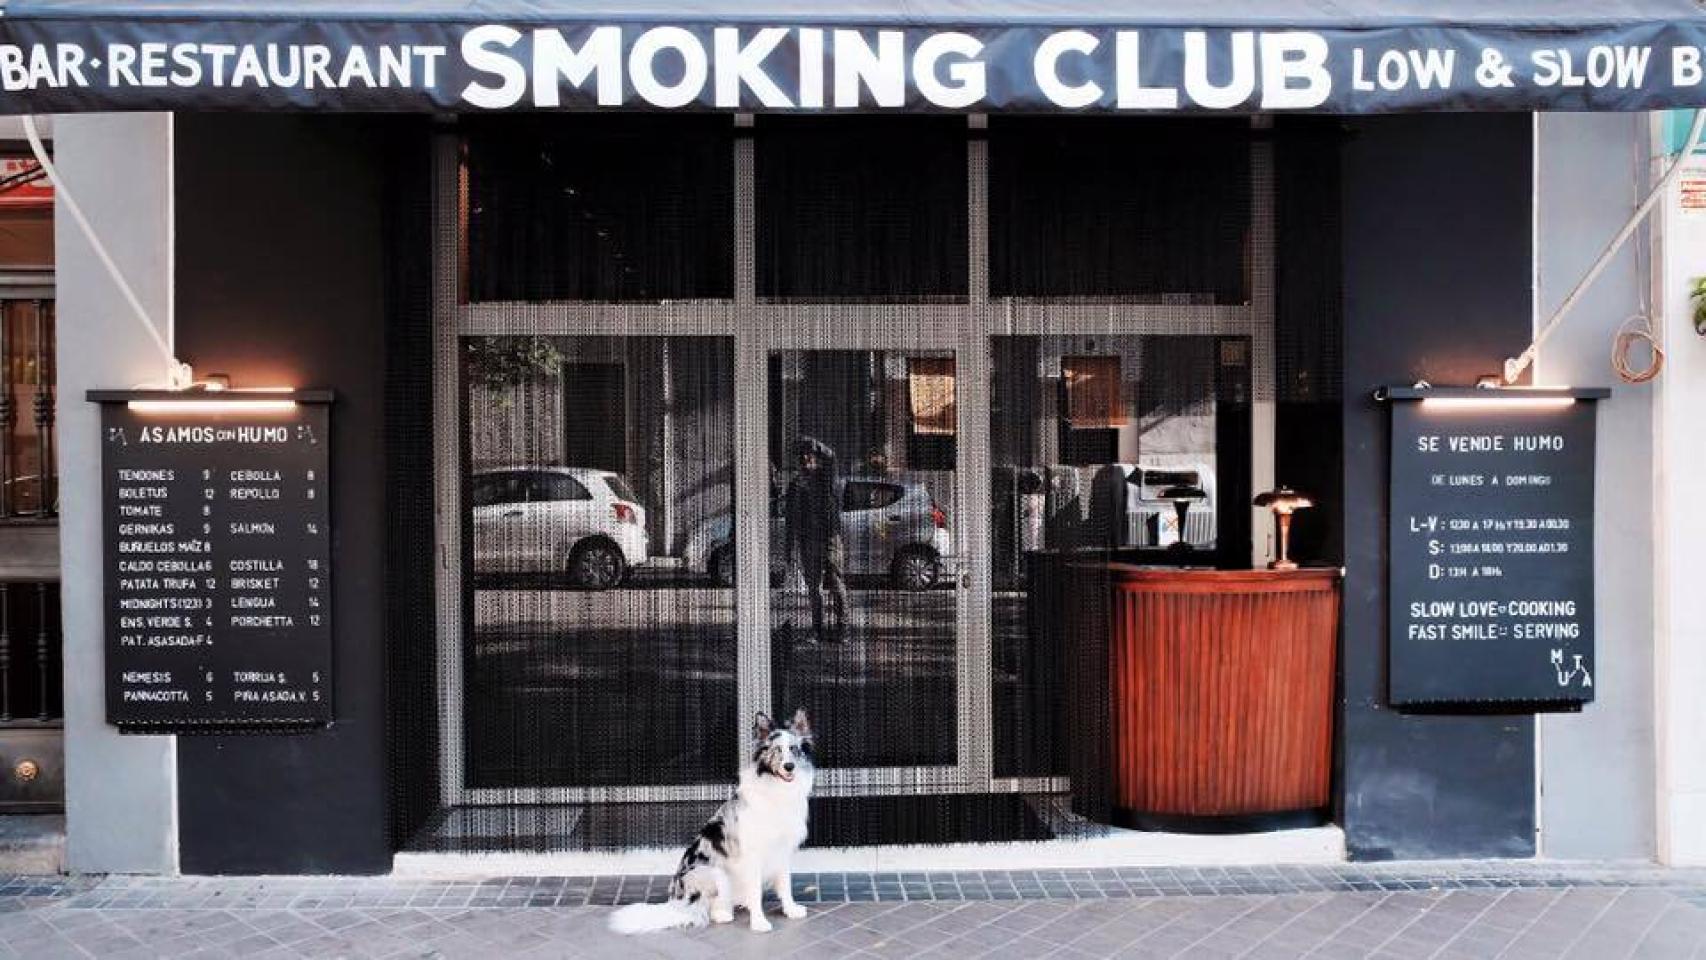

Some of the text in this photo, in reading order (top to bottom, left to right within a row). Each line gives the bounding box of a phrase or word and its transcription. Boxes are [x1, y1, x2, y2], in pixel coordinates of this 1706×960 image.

[0, 44, 446, 91] BAR RESTAURANT
[461, 26, 1332, 109] SMOKING CLUB
[1352, 48, 1457, 91] LOW
[1475, 52, 1514, 88] &
[1531, 47, 1651, 88] SLOW
[140, 427, 214, 443] ASAMOS
[238, 427, 288, 443] HUMO
[1418, 436, 1563, 451] SE VENDE HUMO
[230, 471, 281, 480] CEBOLLA
[1450, 475, 1484, 485] LUNES
[1492, 476, 1498, 485] A
[118, 487, 168, 498] BOLETUS
[230, 488, 279, 498] REPOLLO
[119, 506, 162, 516] TOMATE
[118, 524, 174, 534] GERNIKAS
[119, 561, 153, 571] CALDO
[230, 561, 284, 571] COSTILLA
[1472, 567, 1478, 576] A
[120, 579, 159, 590] PATATA
[164, 579, 196, 589] TRUFA
[230, 578, 279, 589] BRISKET
[231, 597, 275, 608] LENGUA
[1411, 601, 1575, 617] SLOW LOVE COOKING
[230, 617, 294, 626] PORCHETTA
[1409, 623, 1579, 640] FAST SMILE SERVING
